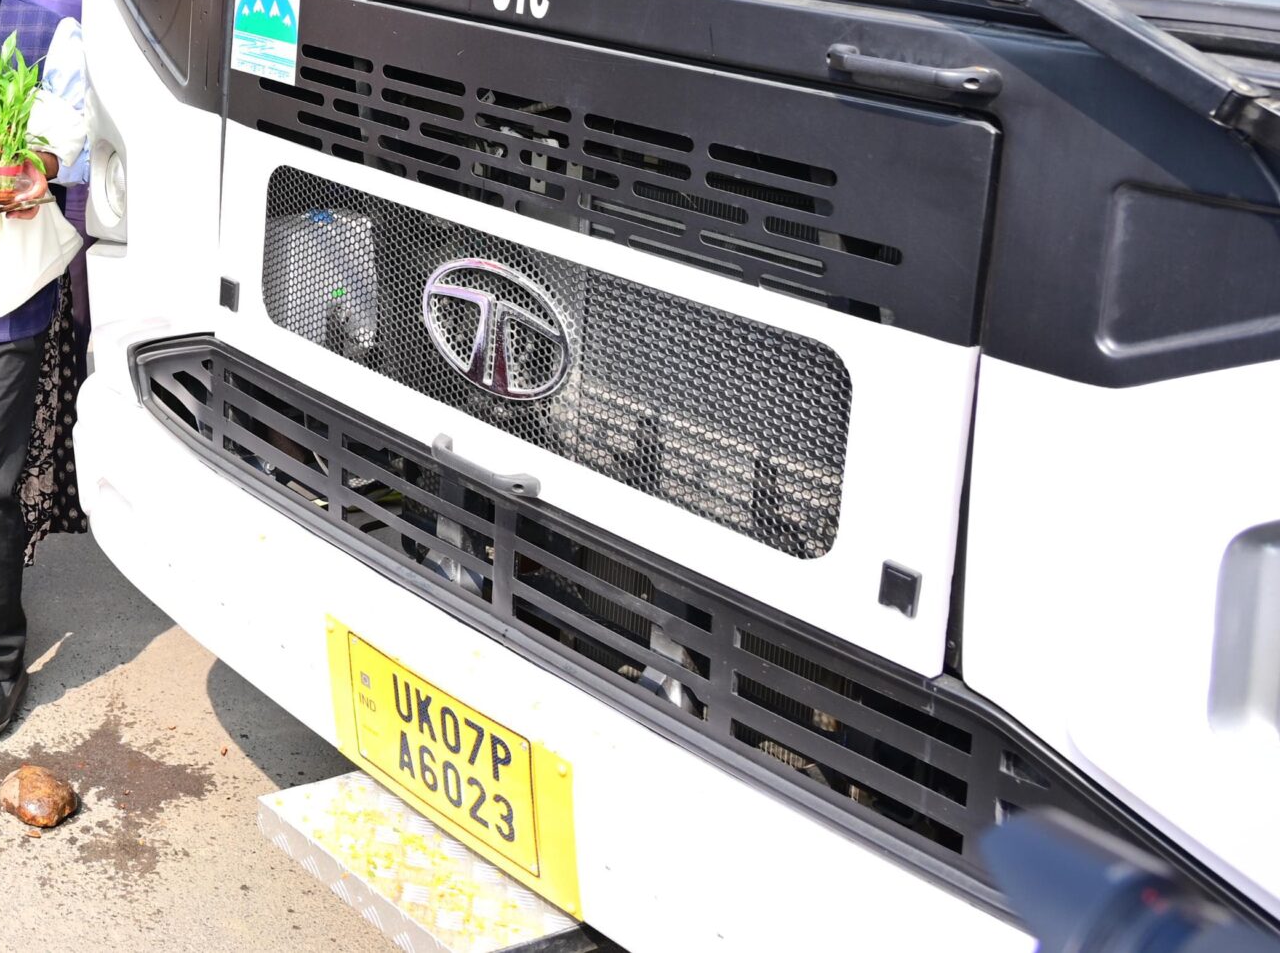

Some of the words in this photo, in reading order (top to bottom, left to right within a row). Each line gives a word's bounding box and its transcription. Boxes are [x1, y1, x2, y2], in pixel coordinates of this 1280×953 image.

[358, 692, 376, 712] IND
[392, 673, 513, 782] UK07P
[399, 730, 516, 843] A6023
